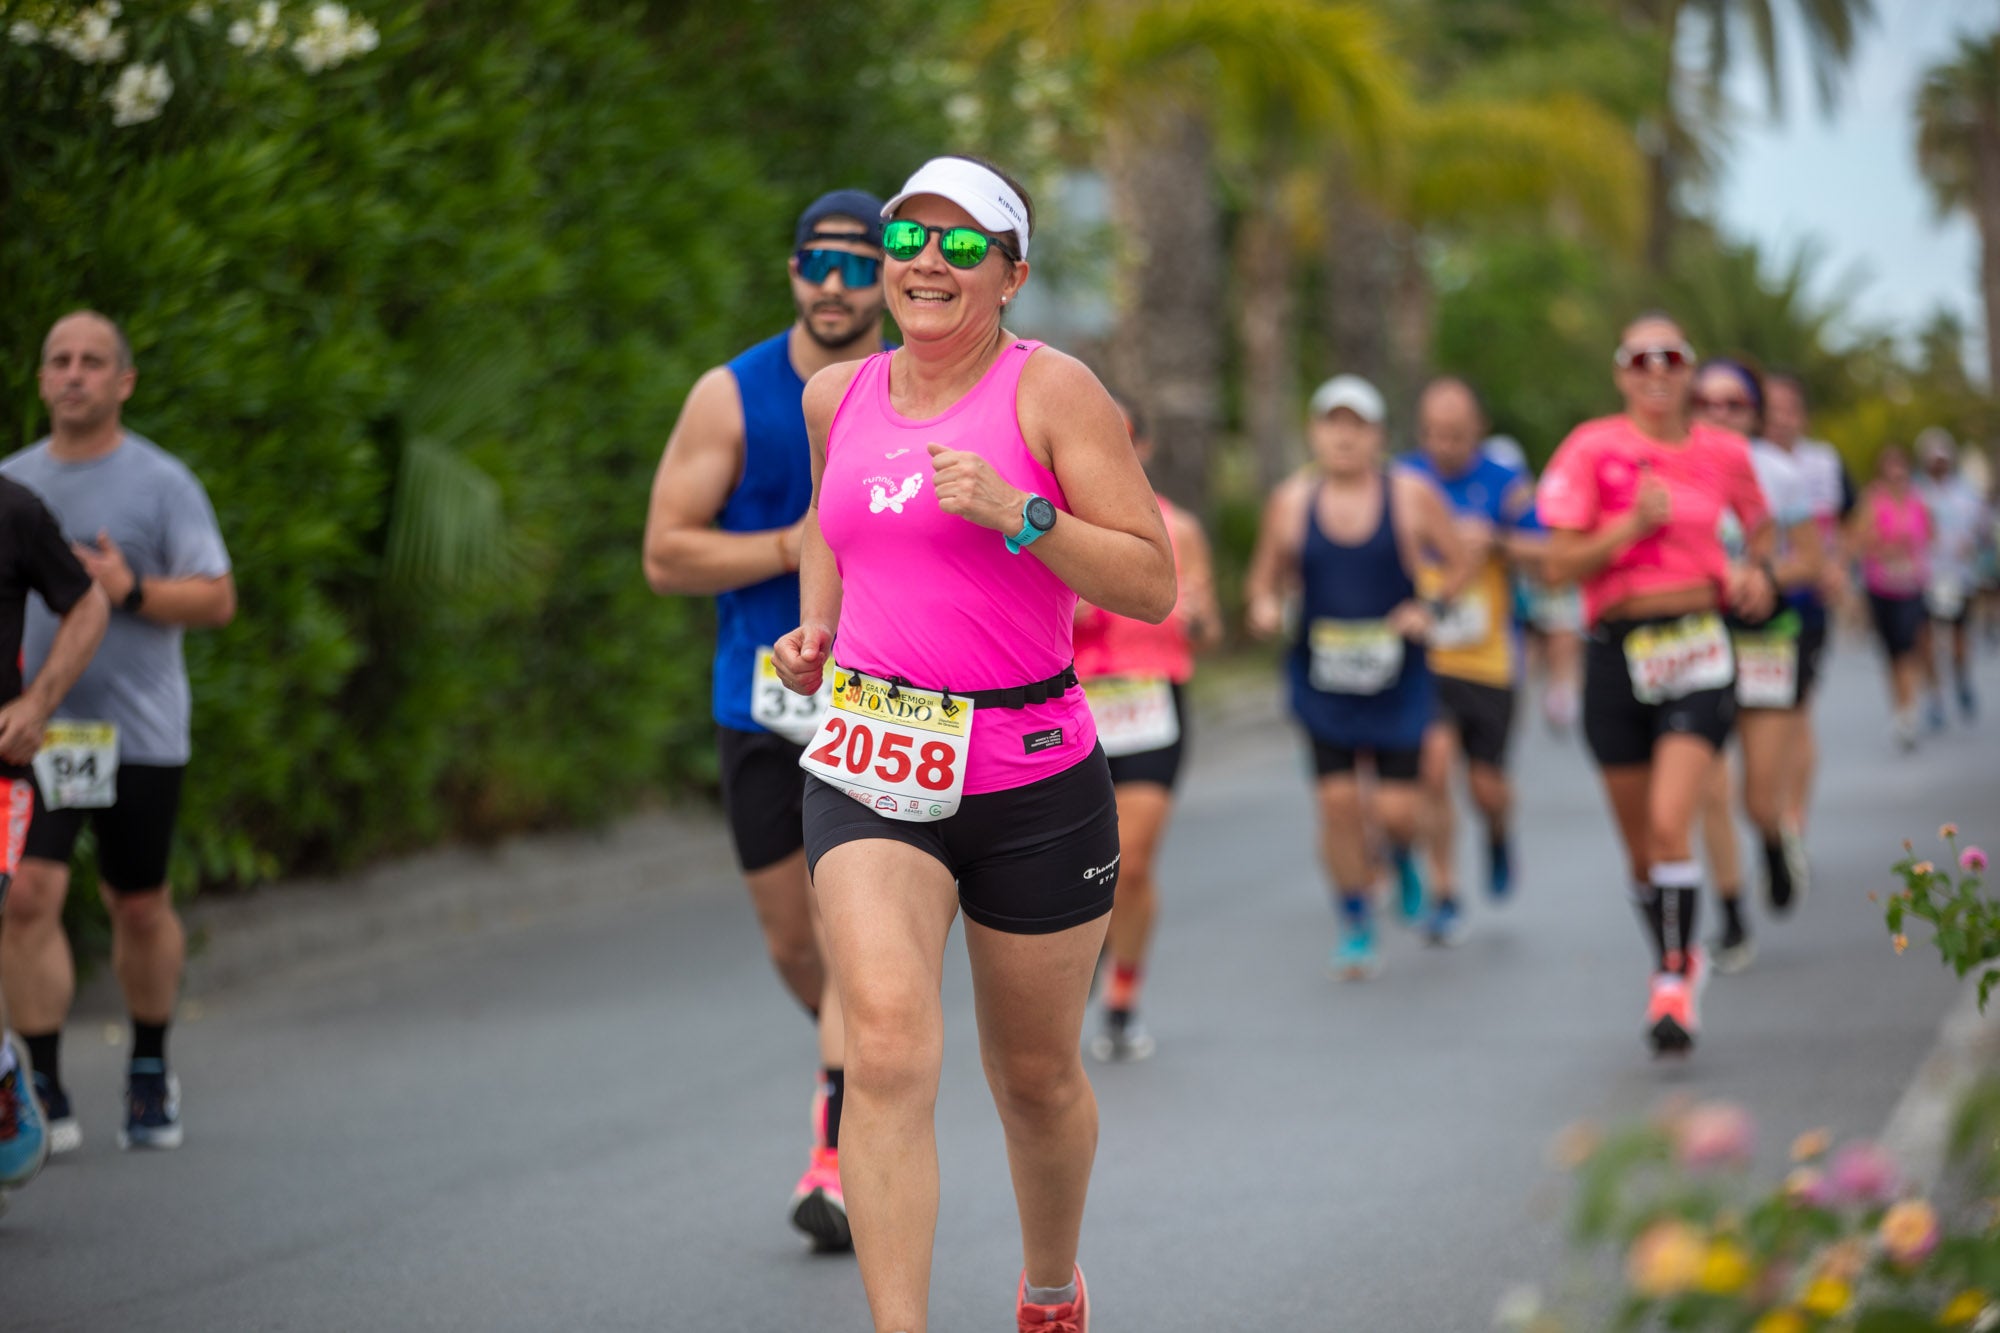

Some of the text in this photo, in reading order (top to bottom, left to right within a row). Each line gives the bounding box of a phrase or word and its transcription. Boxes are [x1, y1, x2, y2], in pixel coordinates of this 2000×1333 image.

[998, 196, 1022, 222] KIPRUN
[863, 476, 898, 494] running
[858, 691, 932, 721] FONDO
[865, 683, 888, 695] GRAN
[895, 693, 926, 705] EMIO
[809, 717, 956, 791] 2058
